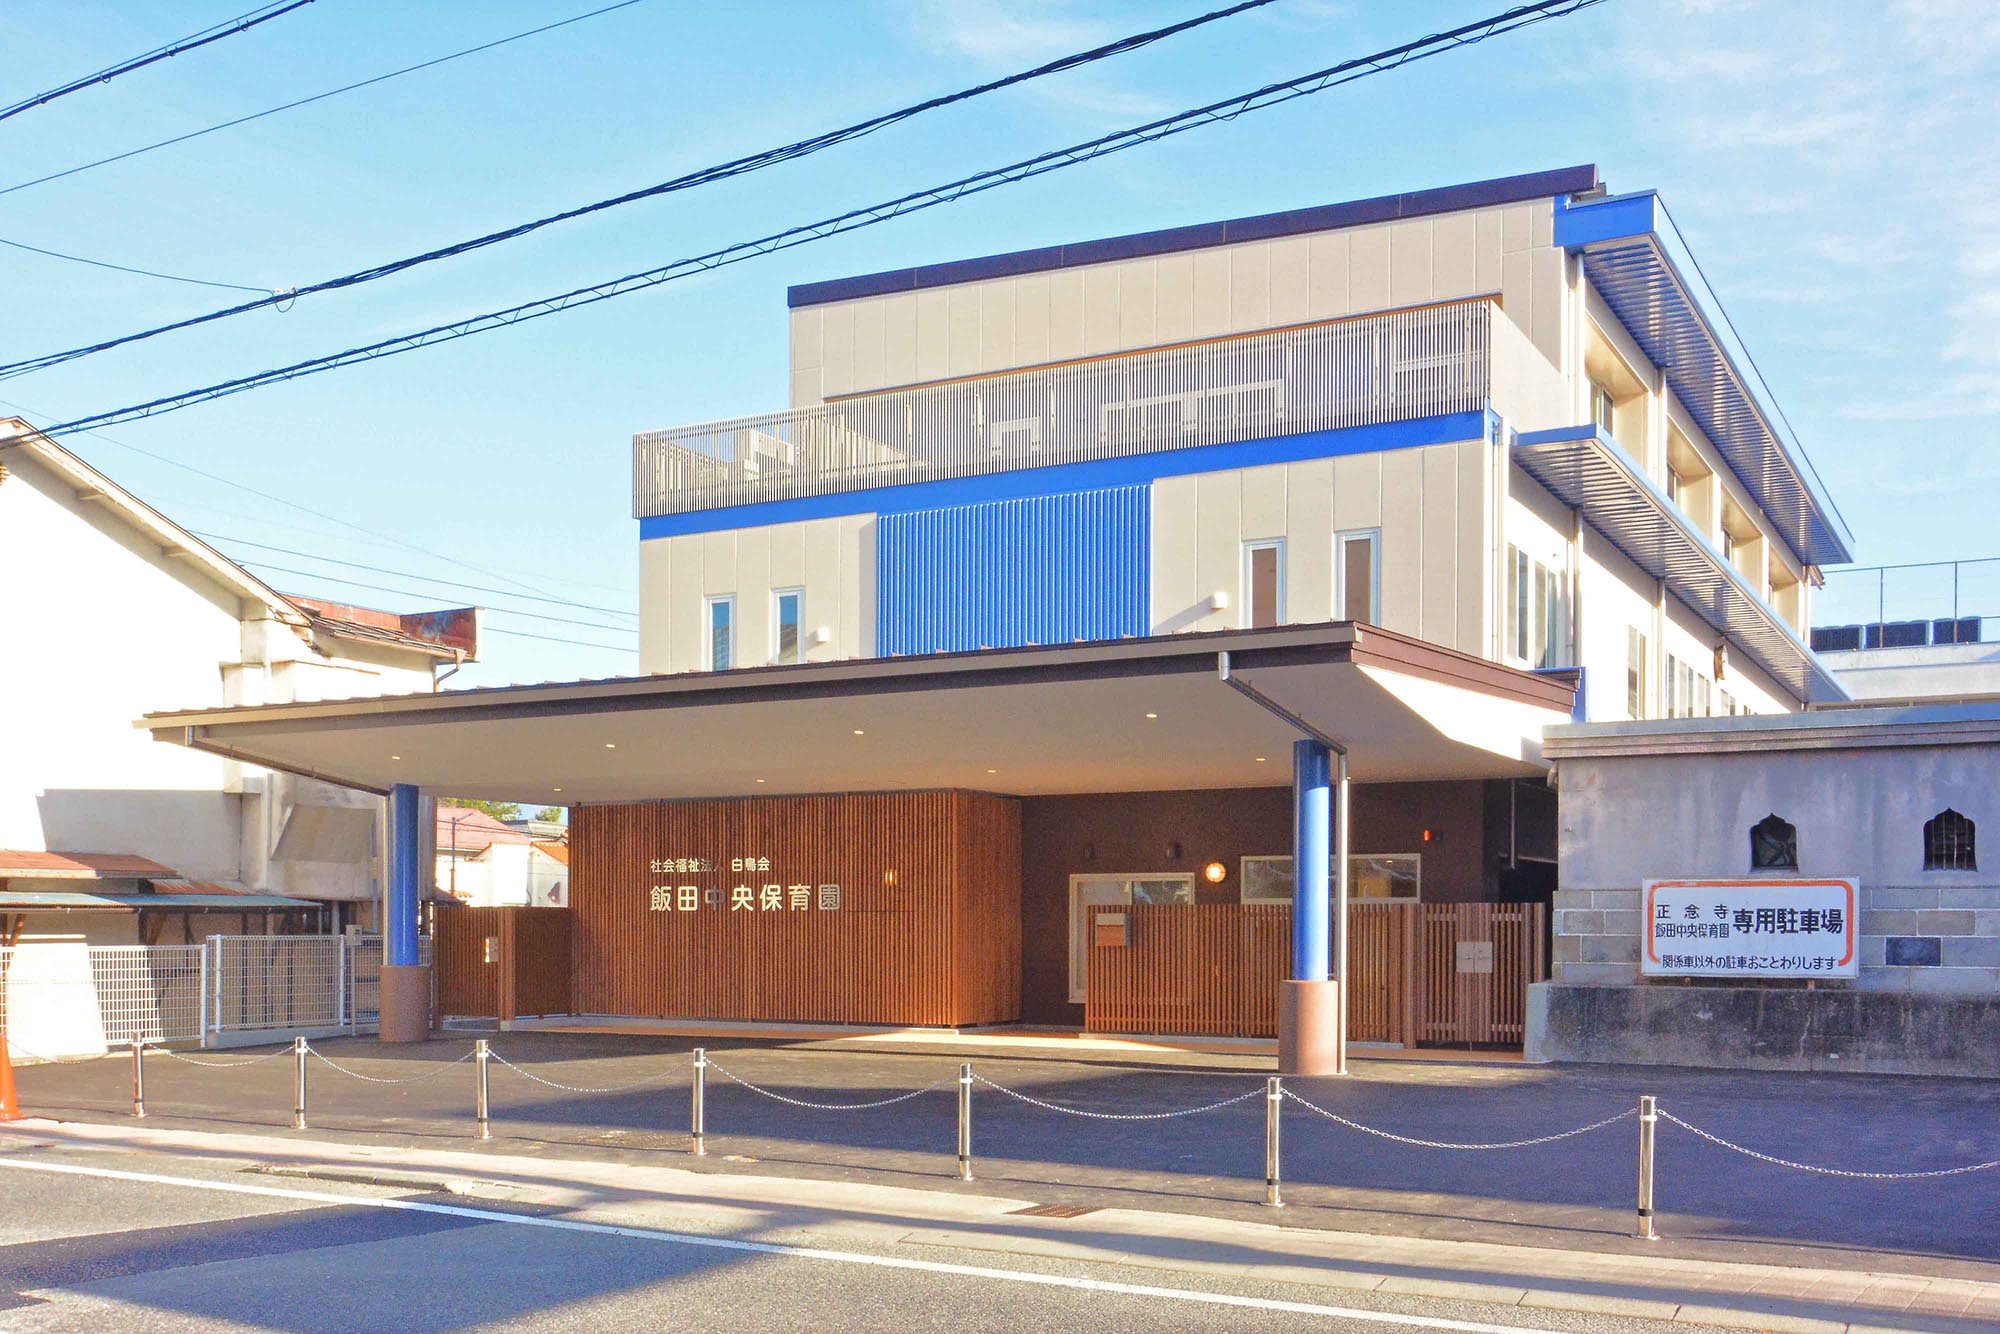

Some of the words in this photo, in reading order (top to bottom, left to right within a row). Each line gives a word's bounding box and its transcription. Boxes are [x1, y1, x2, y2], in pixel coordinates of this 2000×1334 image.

[731, 856, 770, 872] 白鳥会
[650, 884, 841, 912] 飯田中央保育園
[1732, 908, 1844, 934] 専用駐車場
[1655, 922, 1730, 938] 飯田中央保育園
[1662, 954, 1836, 970] 関係車以外の駐車おことわりします
